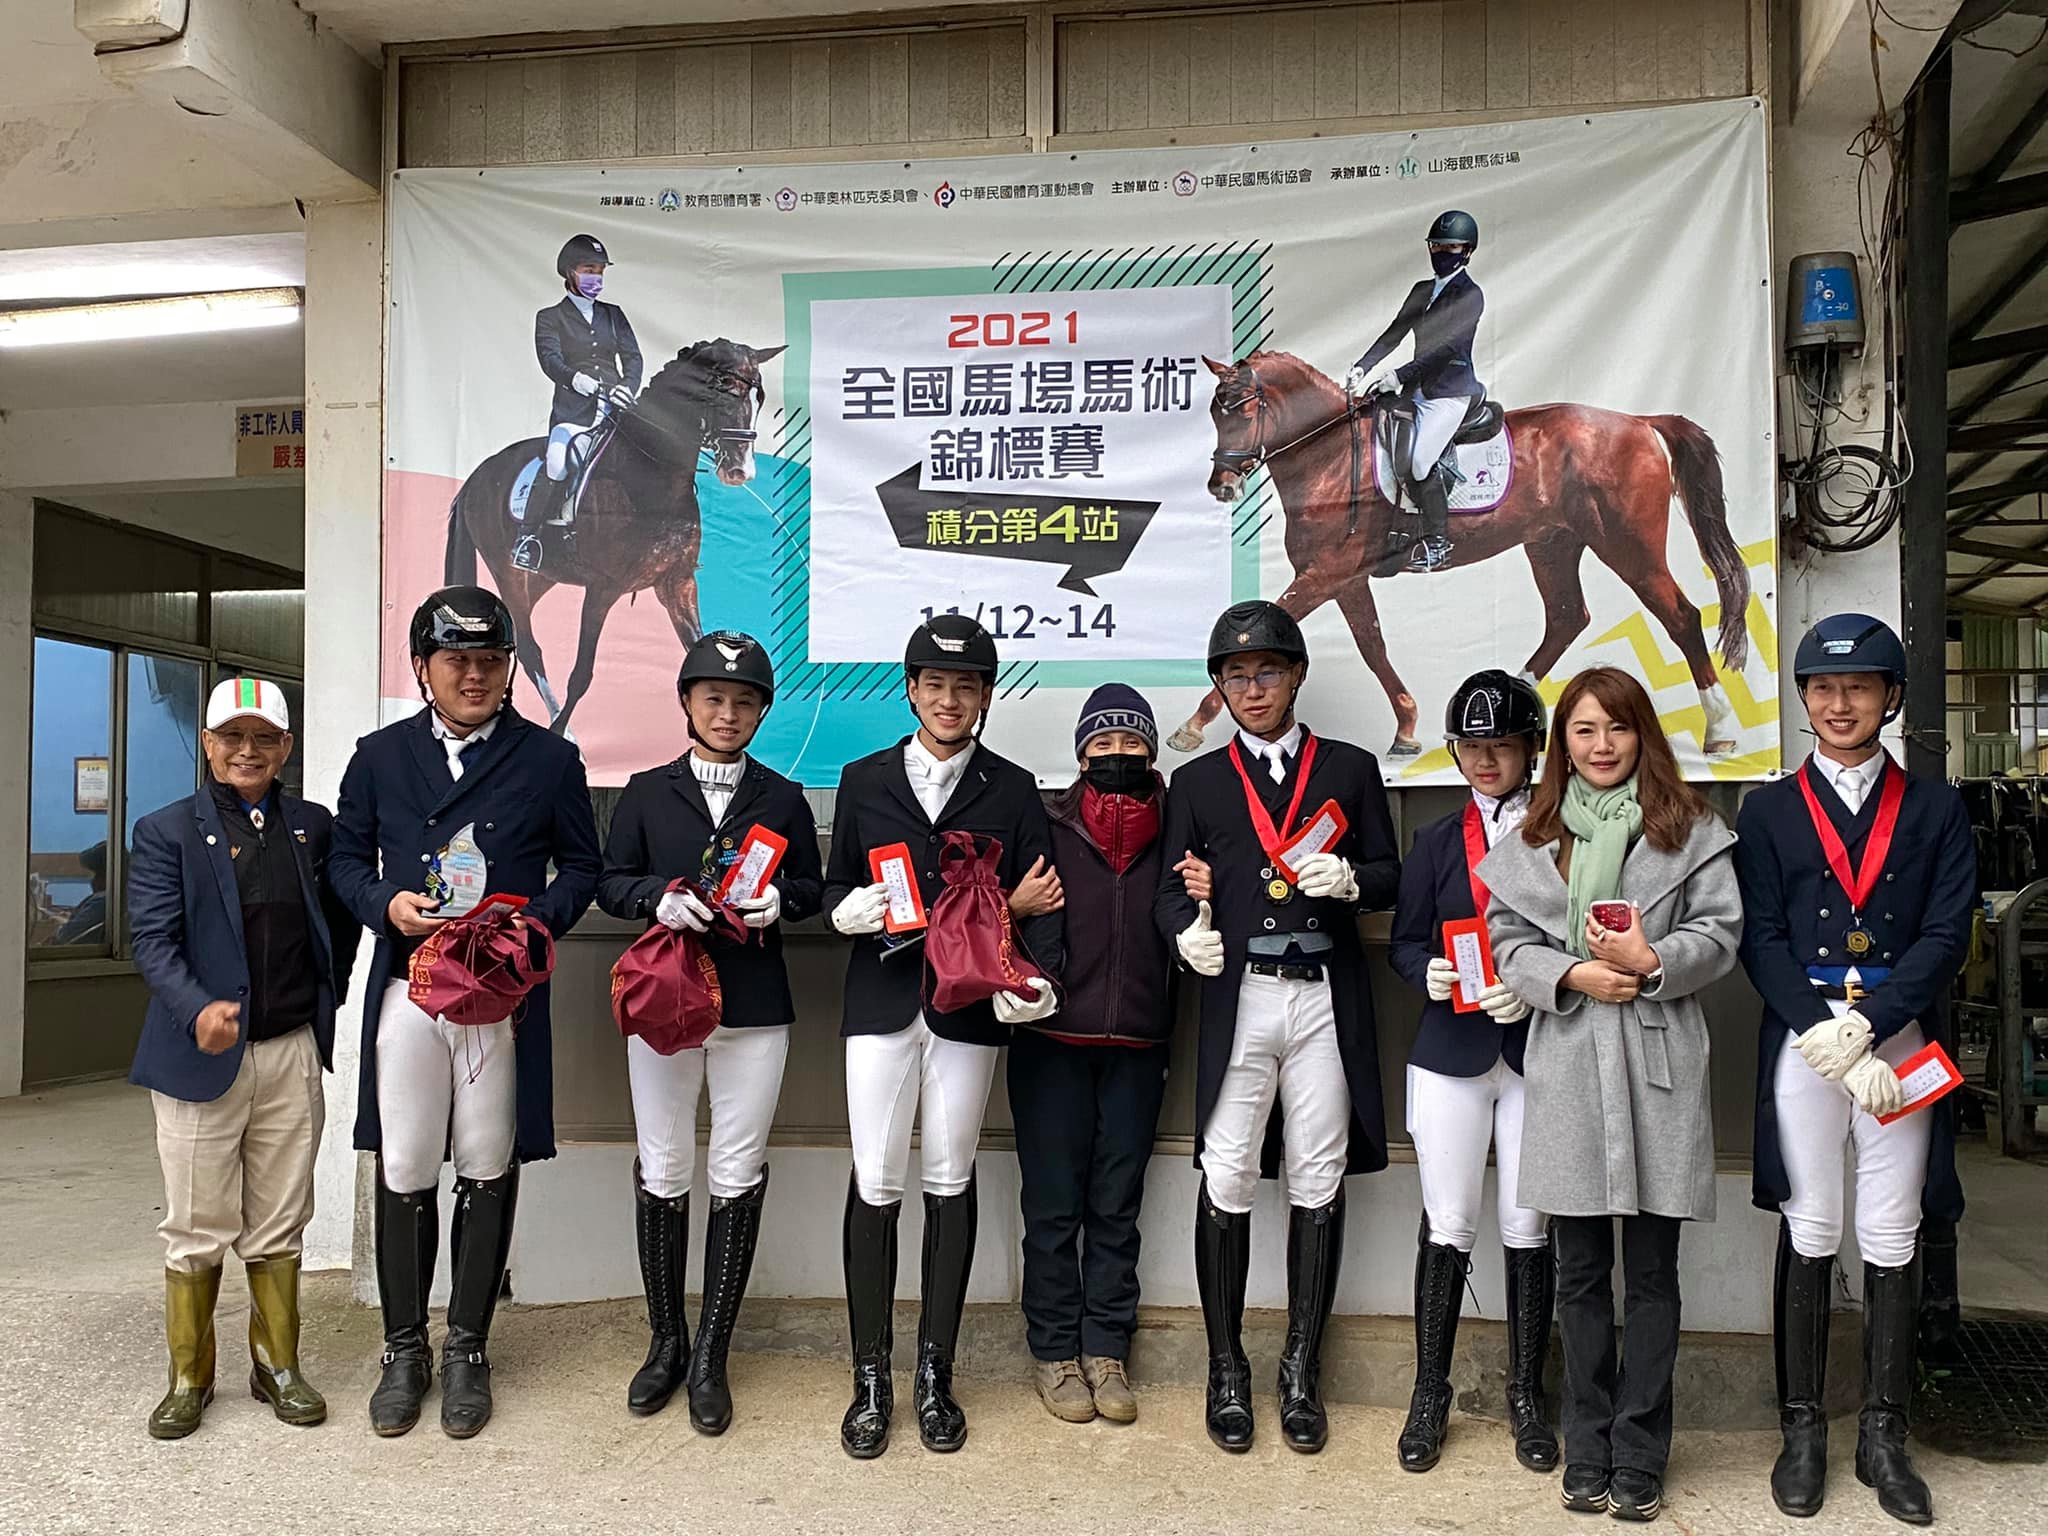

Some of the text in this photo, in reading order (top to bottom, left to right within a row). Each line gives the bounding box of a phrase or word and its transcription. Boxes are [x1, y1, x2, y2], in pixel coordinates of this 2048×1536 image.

[599, 195, 654, 207] 指導單位：
[960, 181, 1095, 201] 中華民國體育運動總會
[1111, 179, 1168, 195] 主辦單位：
[1200, 167, 1313, 189] 中華民國馬術協會
[1330, 164, 1390, 181] 承辦單位：
[1428, 151, 1521, 173] 山海觀馬術場
[947, 310, 1080, 349] 2021
[841, 355, 1198, 421] 全國馬場馬術
[240, 409, 305, 437] 非工作人員
[929, 422, 1105, 482] 錦標賽
[925, 505, 1120, 545] 積分第4站
[920, 602, 1116, 639] 12~14
